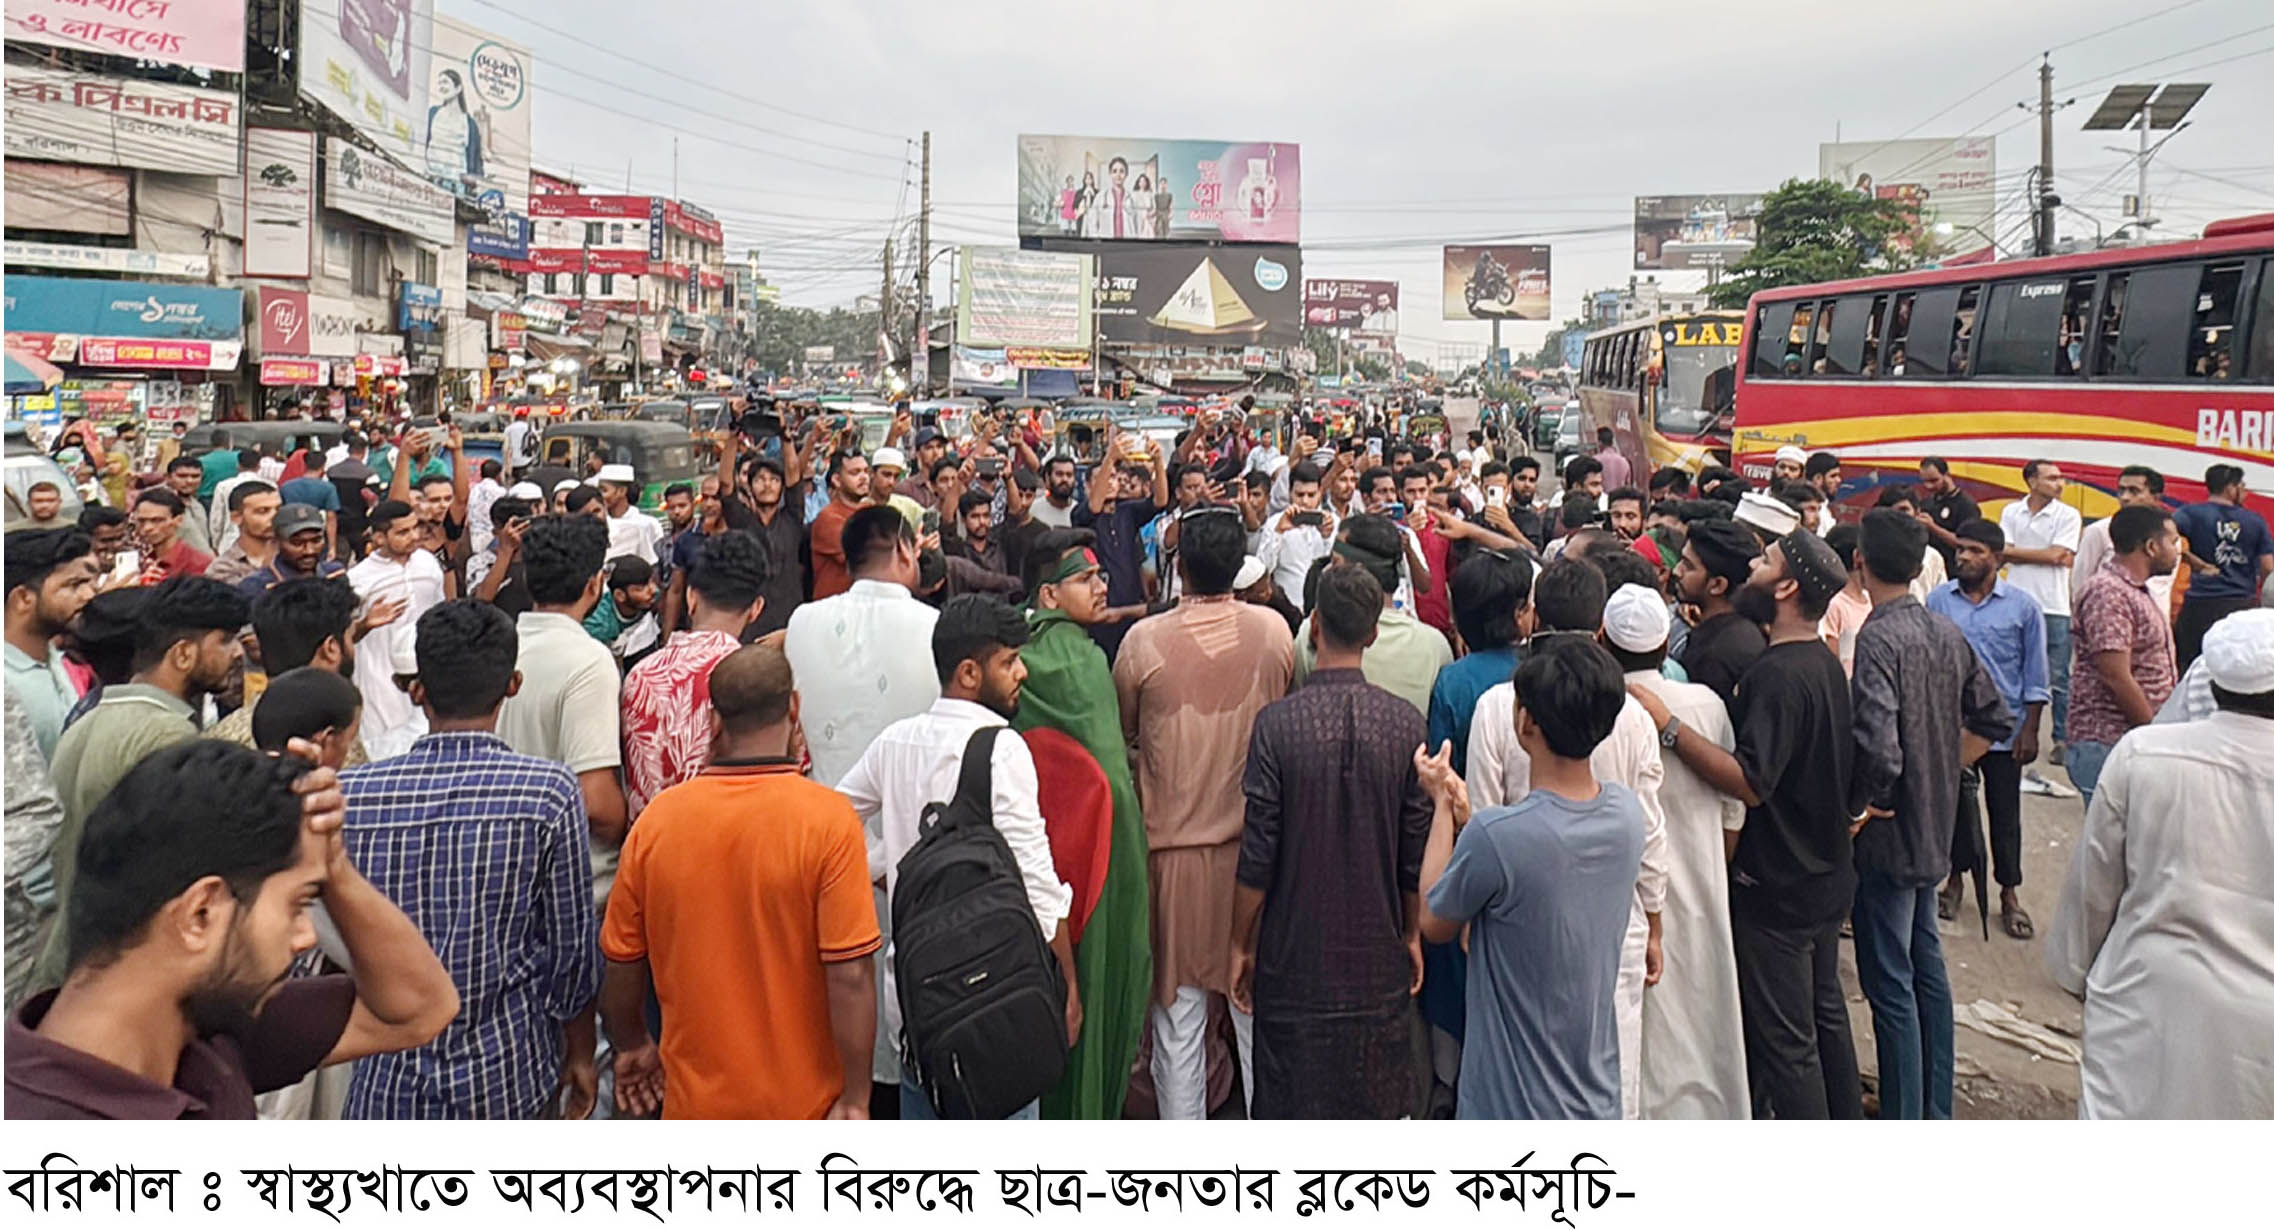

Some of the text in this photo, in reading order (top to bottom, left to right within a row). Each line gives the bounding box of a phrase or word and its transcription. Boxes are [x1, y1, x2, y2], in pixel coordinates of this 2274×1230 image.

[61, 18, 187, 53] লাবণ্যে
[71, 81, 234, 126] পিএলসি
[1308, 281, 1338, 301] Lily
[2021, 284, 2064, 299] Express
[1674, 323, 1743, 346] LAB
[2196, 408, 2274, 453] BARI
